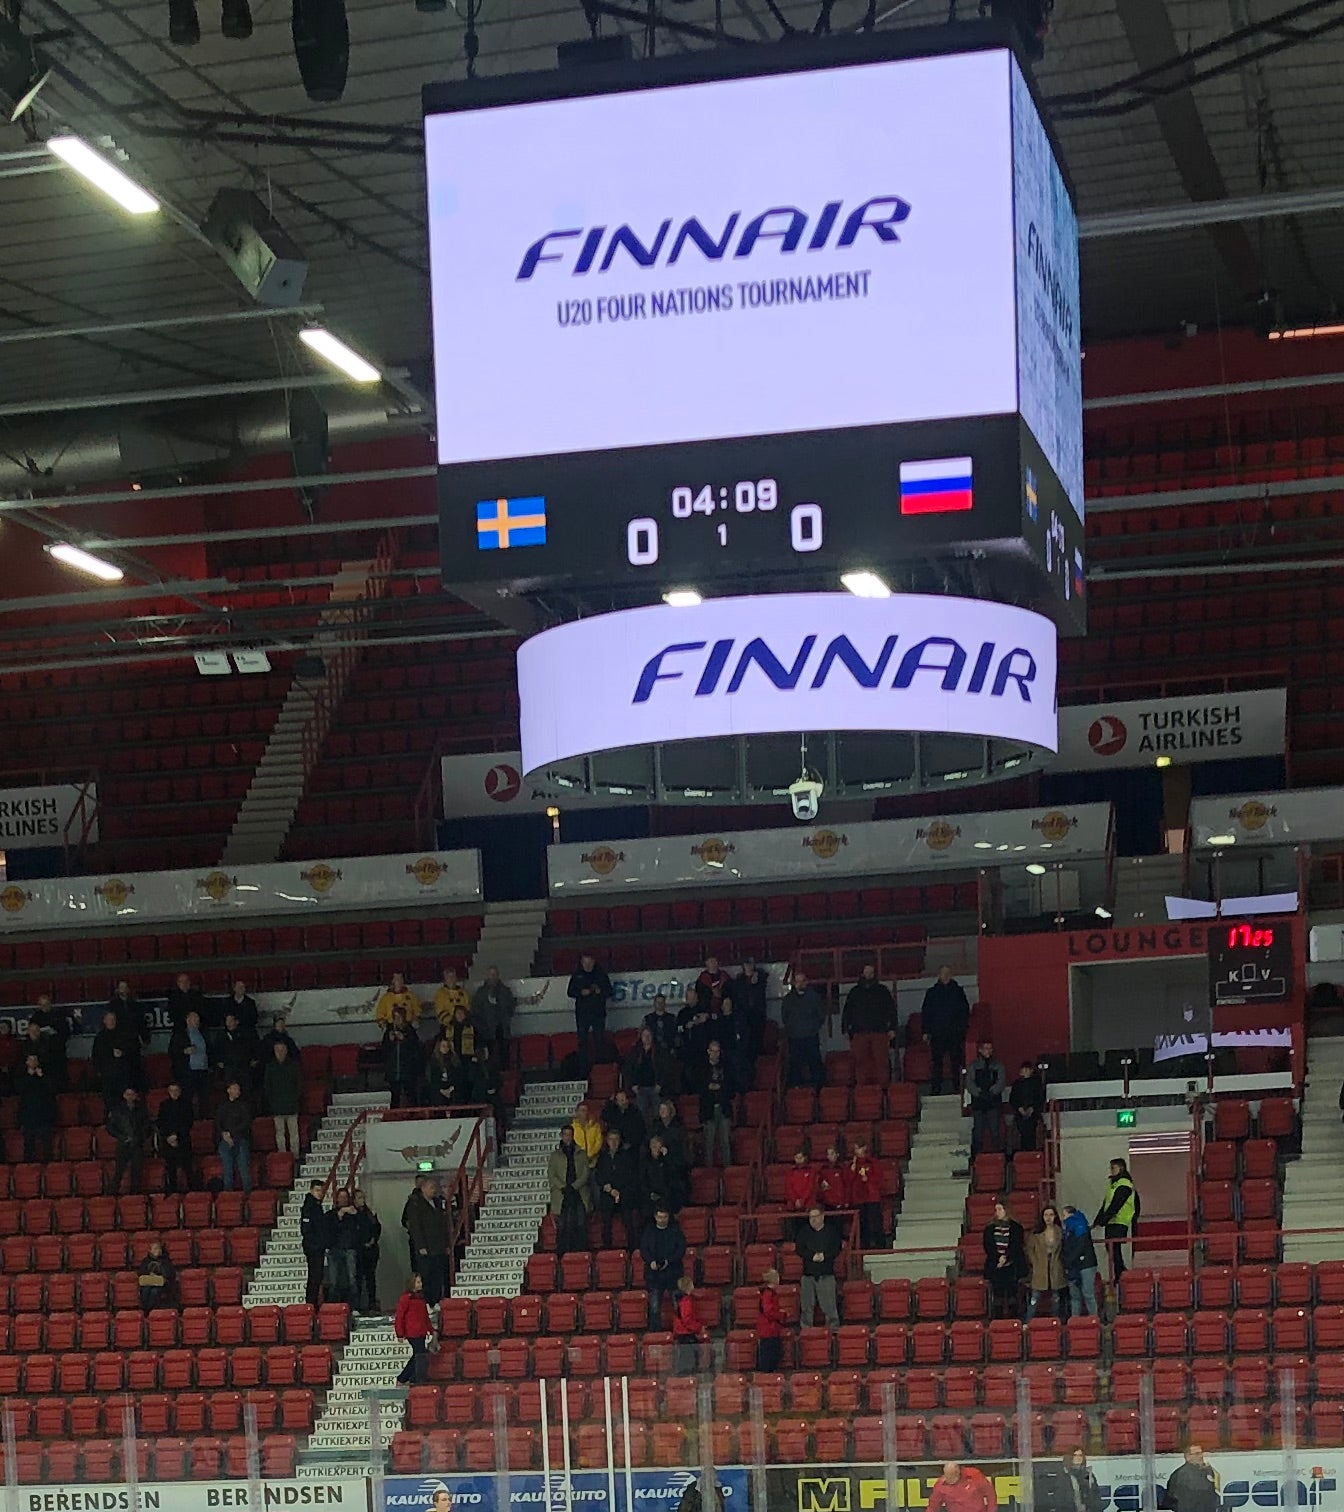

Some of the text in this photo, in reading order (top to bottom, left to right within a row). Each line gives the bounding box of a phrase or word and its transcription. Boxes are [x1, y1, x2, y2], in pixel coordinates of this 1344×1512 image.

[515, 194, 912, 283] FINNAIR
[556, 269, 872, 328] U20 FOUR NATIONS TOURNAMENT
[671, 478, 778, 518] 04:09
[627, 517, 659, 566] 0
[716, 523, 729, 548] 1
[791, 503, 823, 553] 0
[632, 633, 1038, 706] FINNAIR
[1138, 705, 1242, 731] TURKISH
[1138, 726, 1243, 754] AIRLINES
[1067, 927, 1208, 956] LOUNGE
[346, 1346, 410, 1358] PUTKIEXPERT
[317, 1422, 382, 1435] PUTKIEXPET
[311, 1437, 371, 1449] PUTKIEXPER
[298, 1466, 364, 1478] PUTKIEXPERT
[29, 1490, 160, 1511] BERENDSEN
